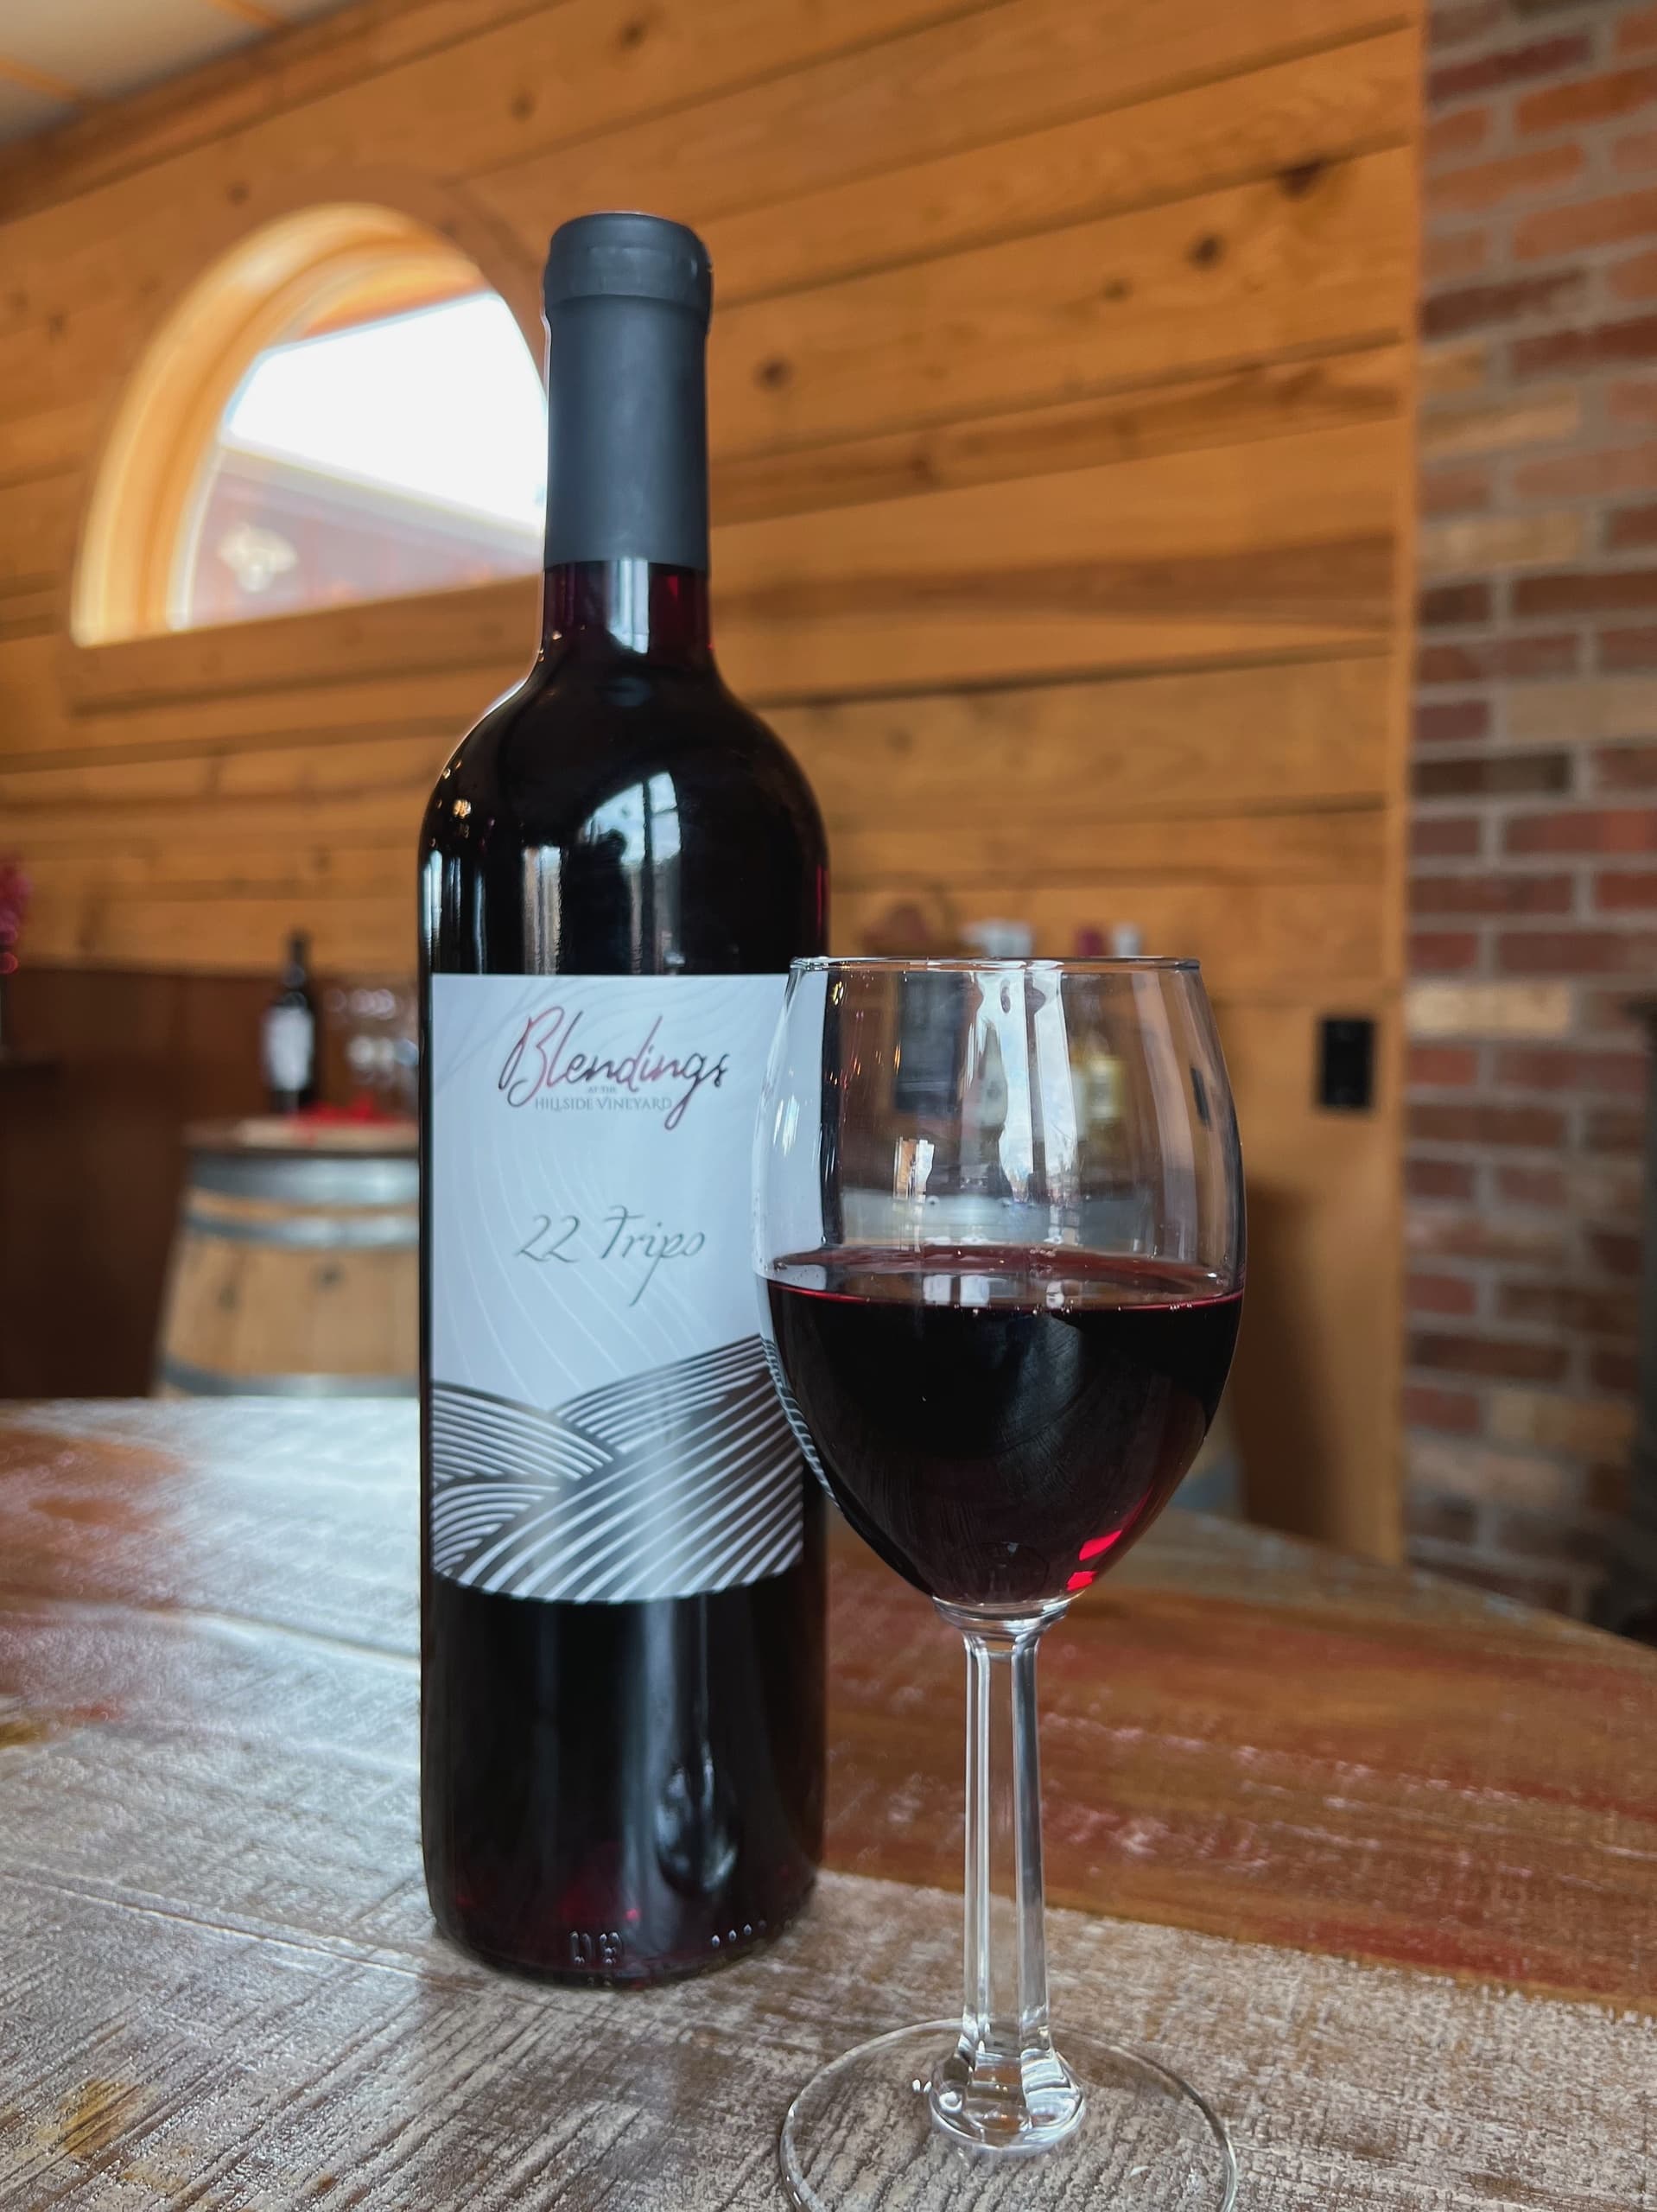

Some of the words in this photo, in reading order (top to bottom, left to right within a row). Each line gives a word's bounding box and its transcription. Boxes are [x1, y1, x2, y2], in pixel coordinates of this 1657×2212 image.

[498, 1006, 730, 1130] Blendings
[535, 1096, 594, 1112] HILLSIDE
[596, 1096, 673, 1112] VINEYARD
[513, 1214, 581, 1263] 22
